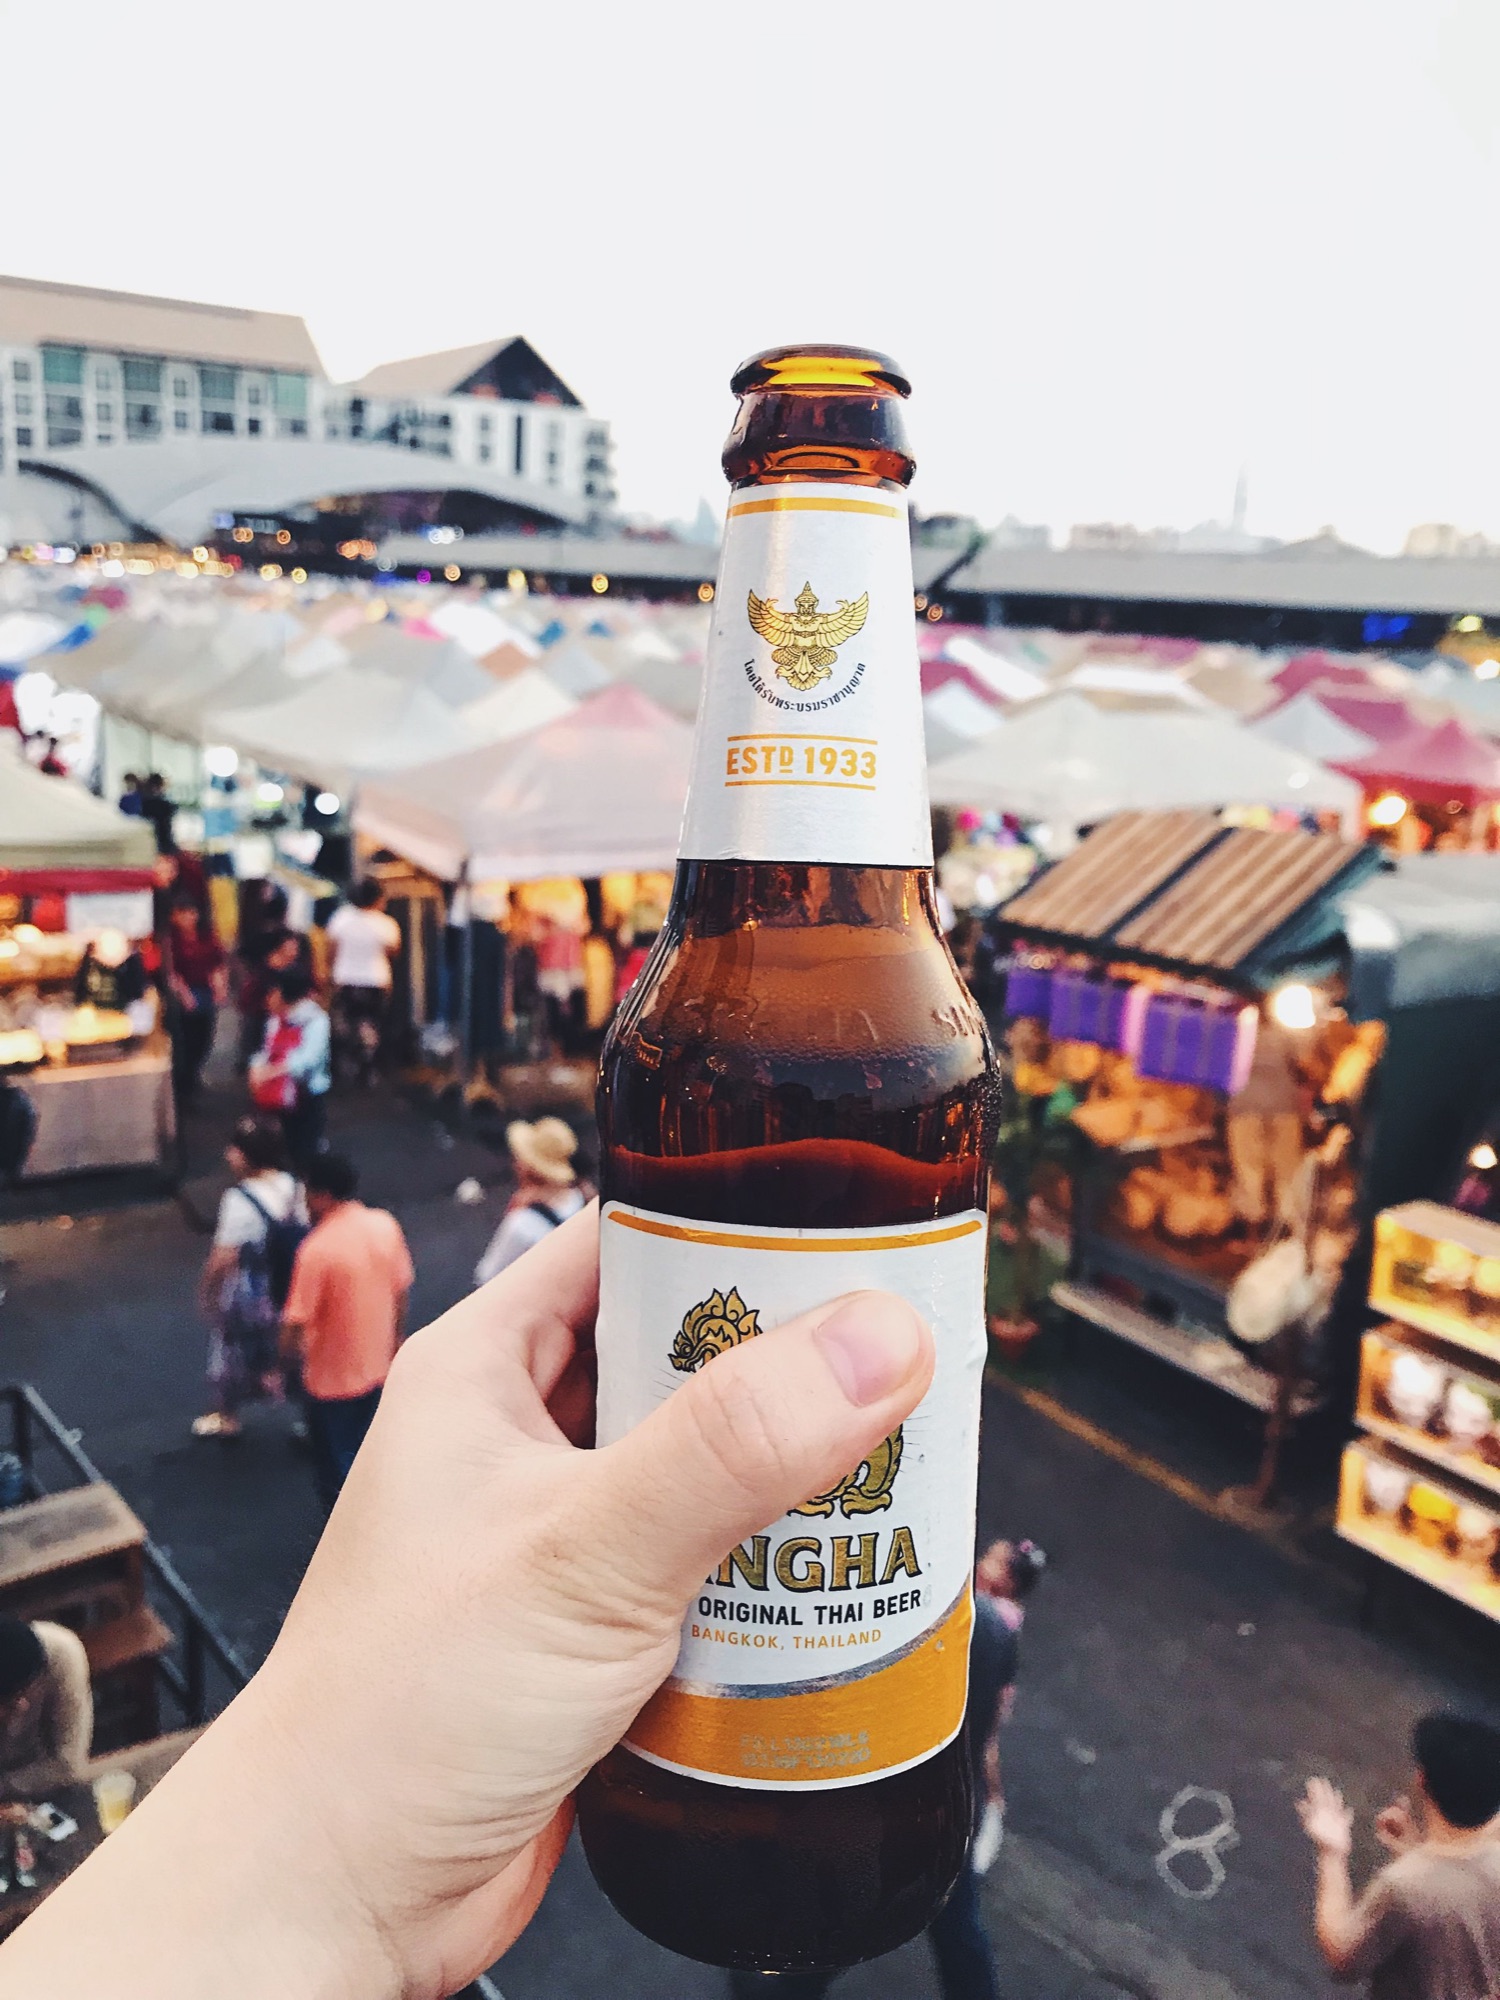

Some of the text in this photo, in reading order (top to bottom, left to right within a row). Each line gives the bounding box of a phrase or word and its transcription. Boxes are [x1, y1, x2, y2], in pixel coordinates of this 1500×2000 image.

[726, 745, 877, 779] ESTD 1933
[705, 1526, 923, 1593] NGHA
[698, 1589, 921, 1626] ORIGINAL THAI BEER
[691, 1624, 882, 1650] BANGKOK, THAILAND
